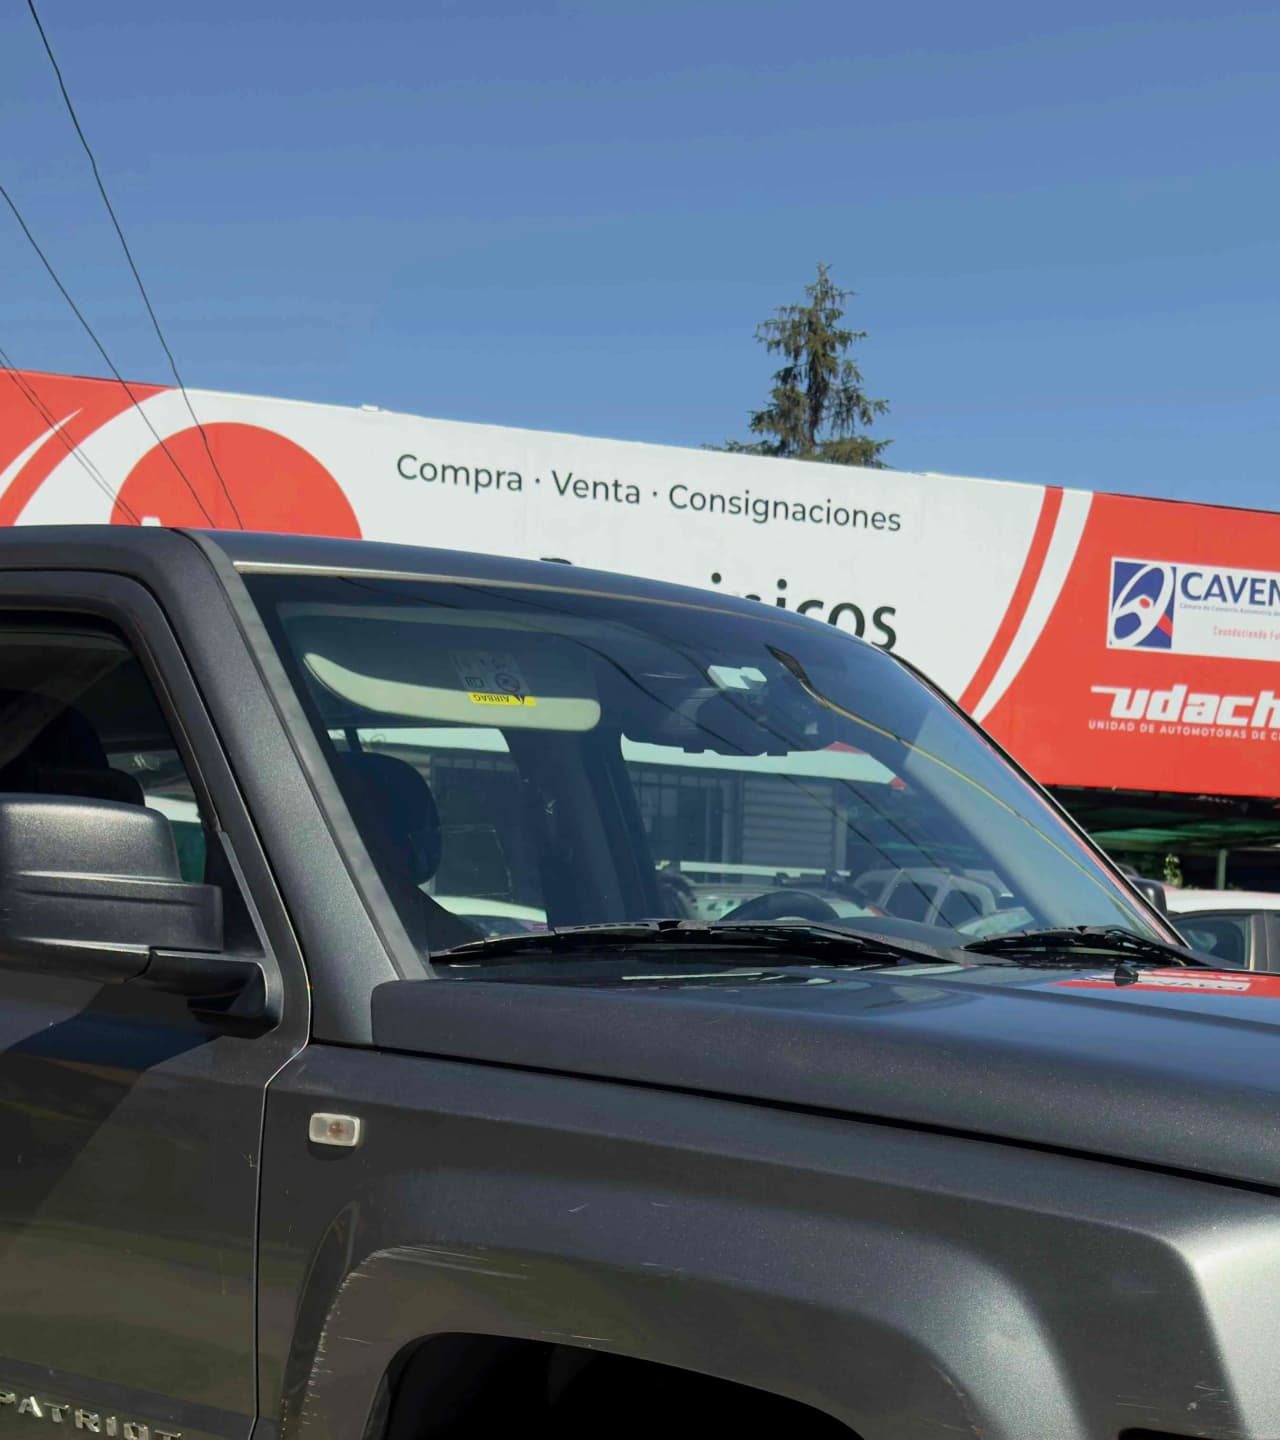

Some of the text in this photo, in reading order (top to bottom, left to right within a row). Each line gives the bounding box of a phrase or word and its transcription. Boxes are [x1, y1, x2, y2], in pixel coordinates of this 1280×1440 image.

[396, 453, 902, 532] Compra Venta Consignaciones
[1088, 719, 1136, 732] UNIDAD
[1140, 724, 1156, 734] DE
[1160, 726, 1248, 740] AUTOMOTORAS
[1251, 731, 1267, 741] DE
